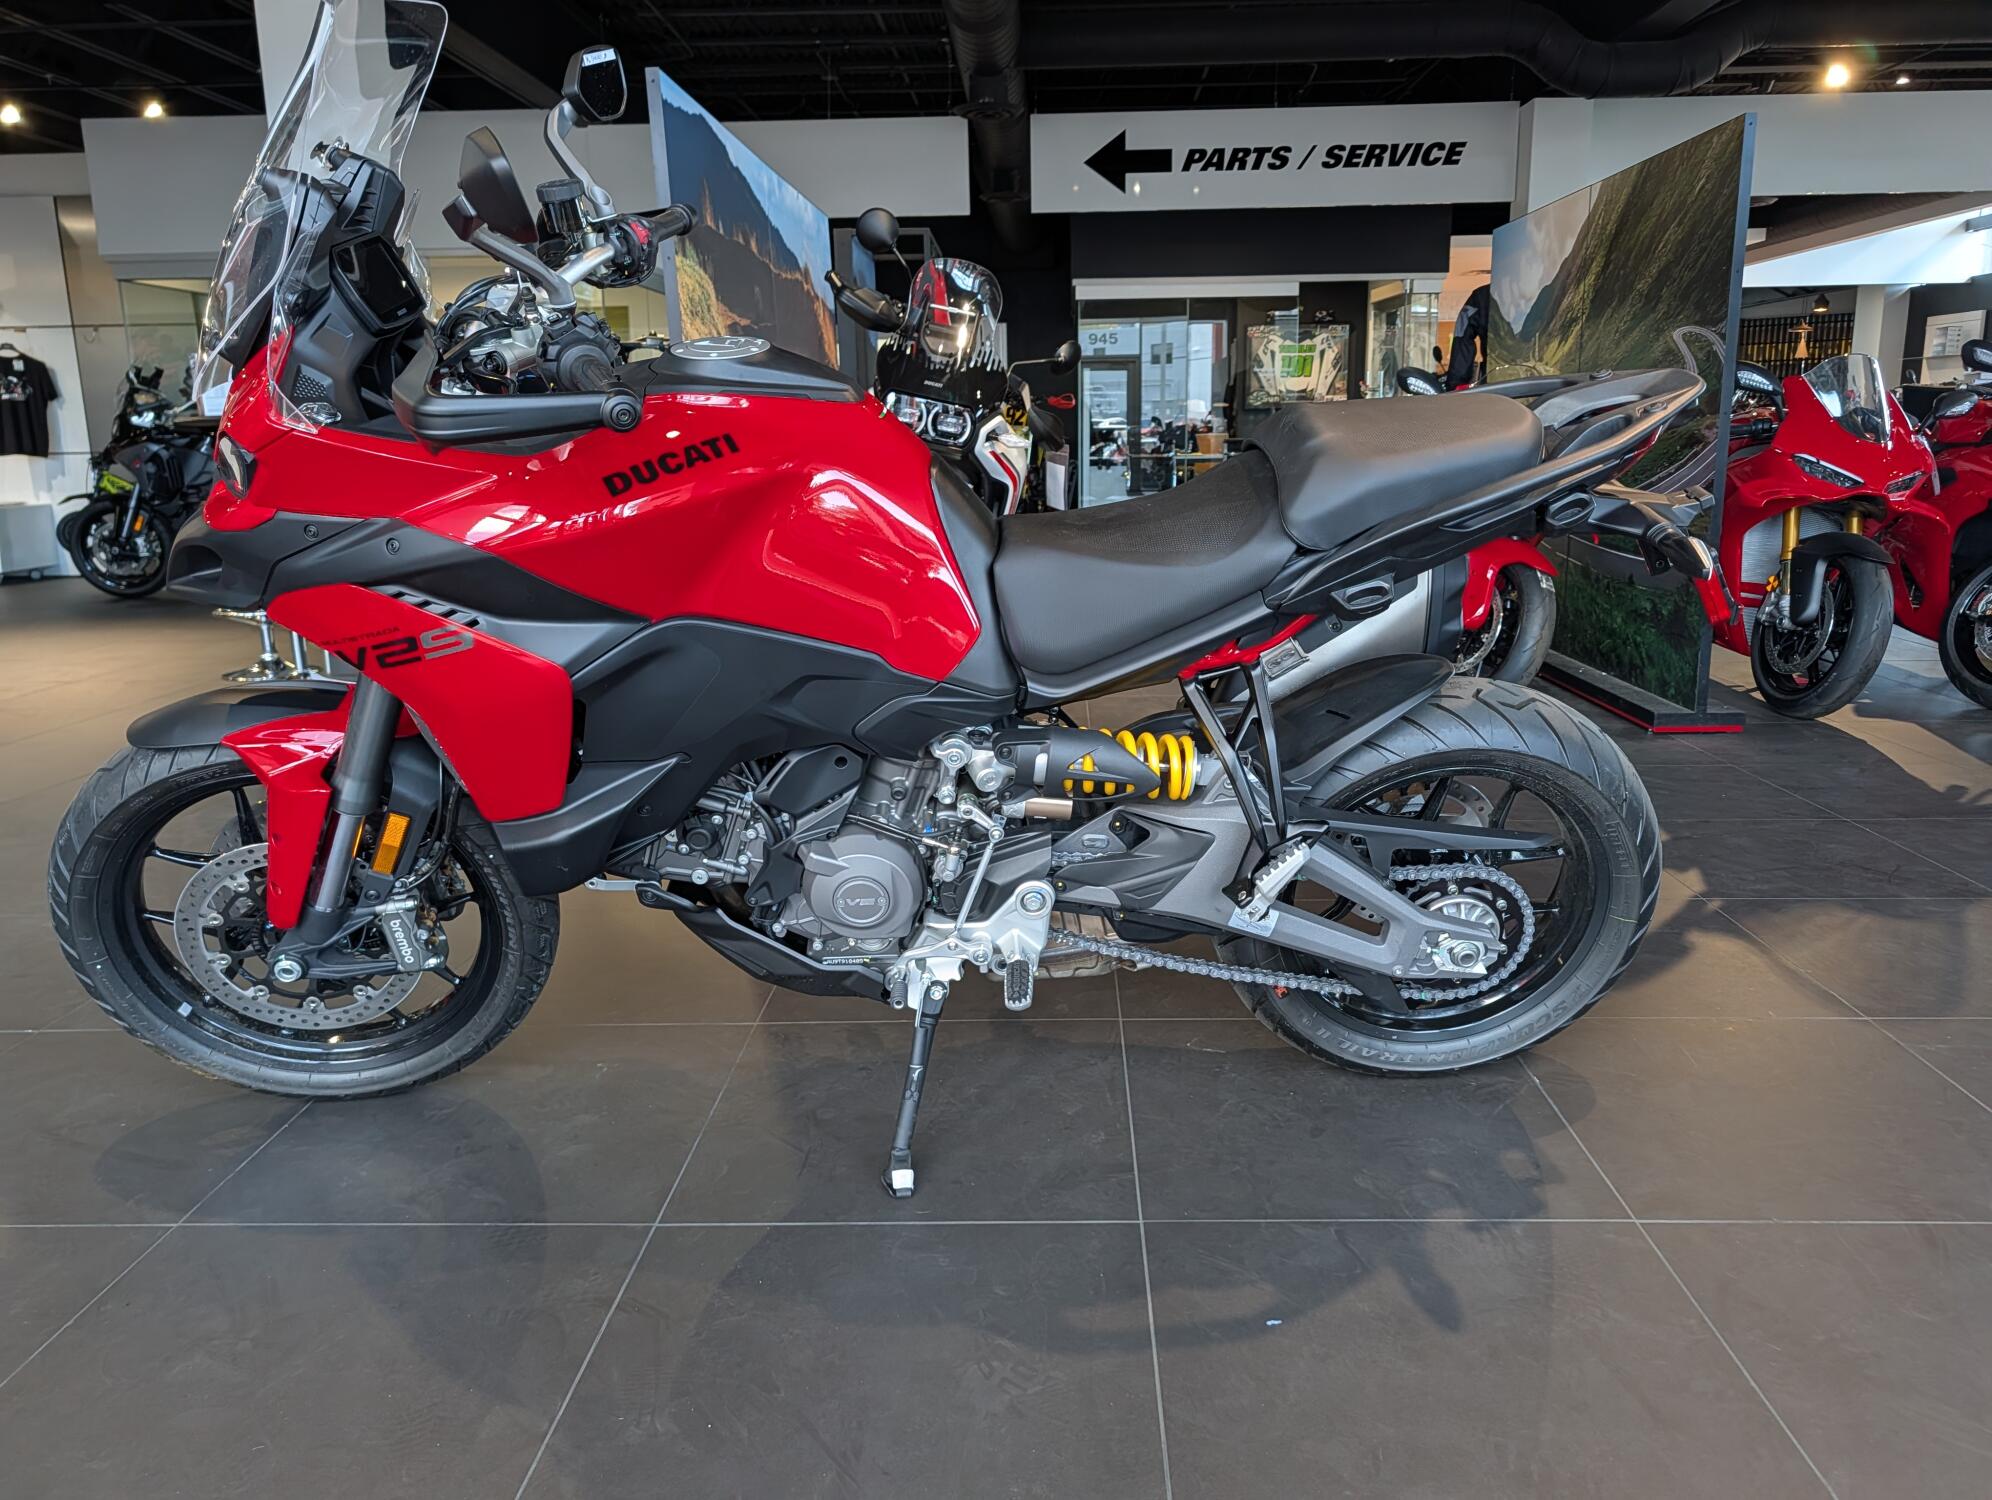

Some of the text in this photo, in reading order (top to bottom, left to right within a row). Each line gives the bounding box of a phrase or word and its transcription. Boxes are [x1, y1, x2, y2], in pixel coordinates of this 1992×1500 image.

[1181, 141, 1468, 173] PARTS / SERVICE
[1088, 332, 1119, 346] 945
[602, 432, 740, 498] DUCATI
[389, 918, 415, 965] brembo
